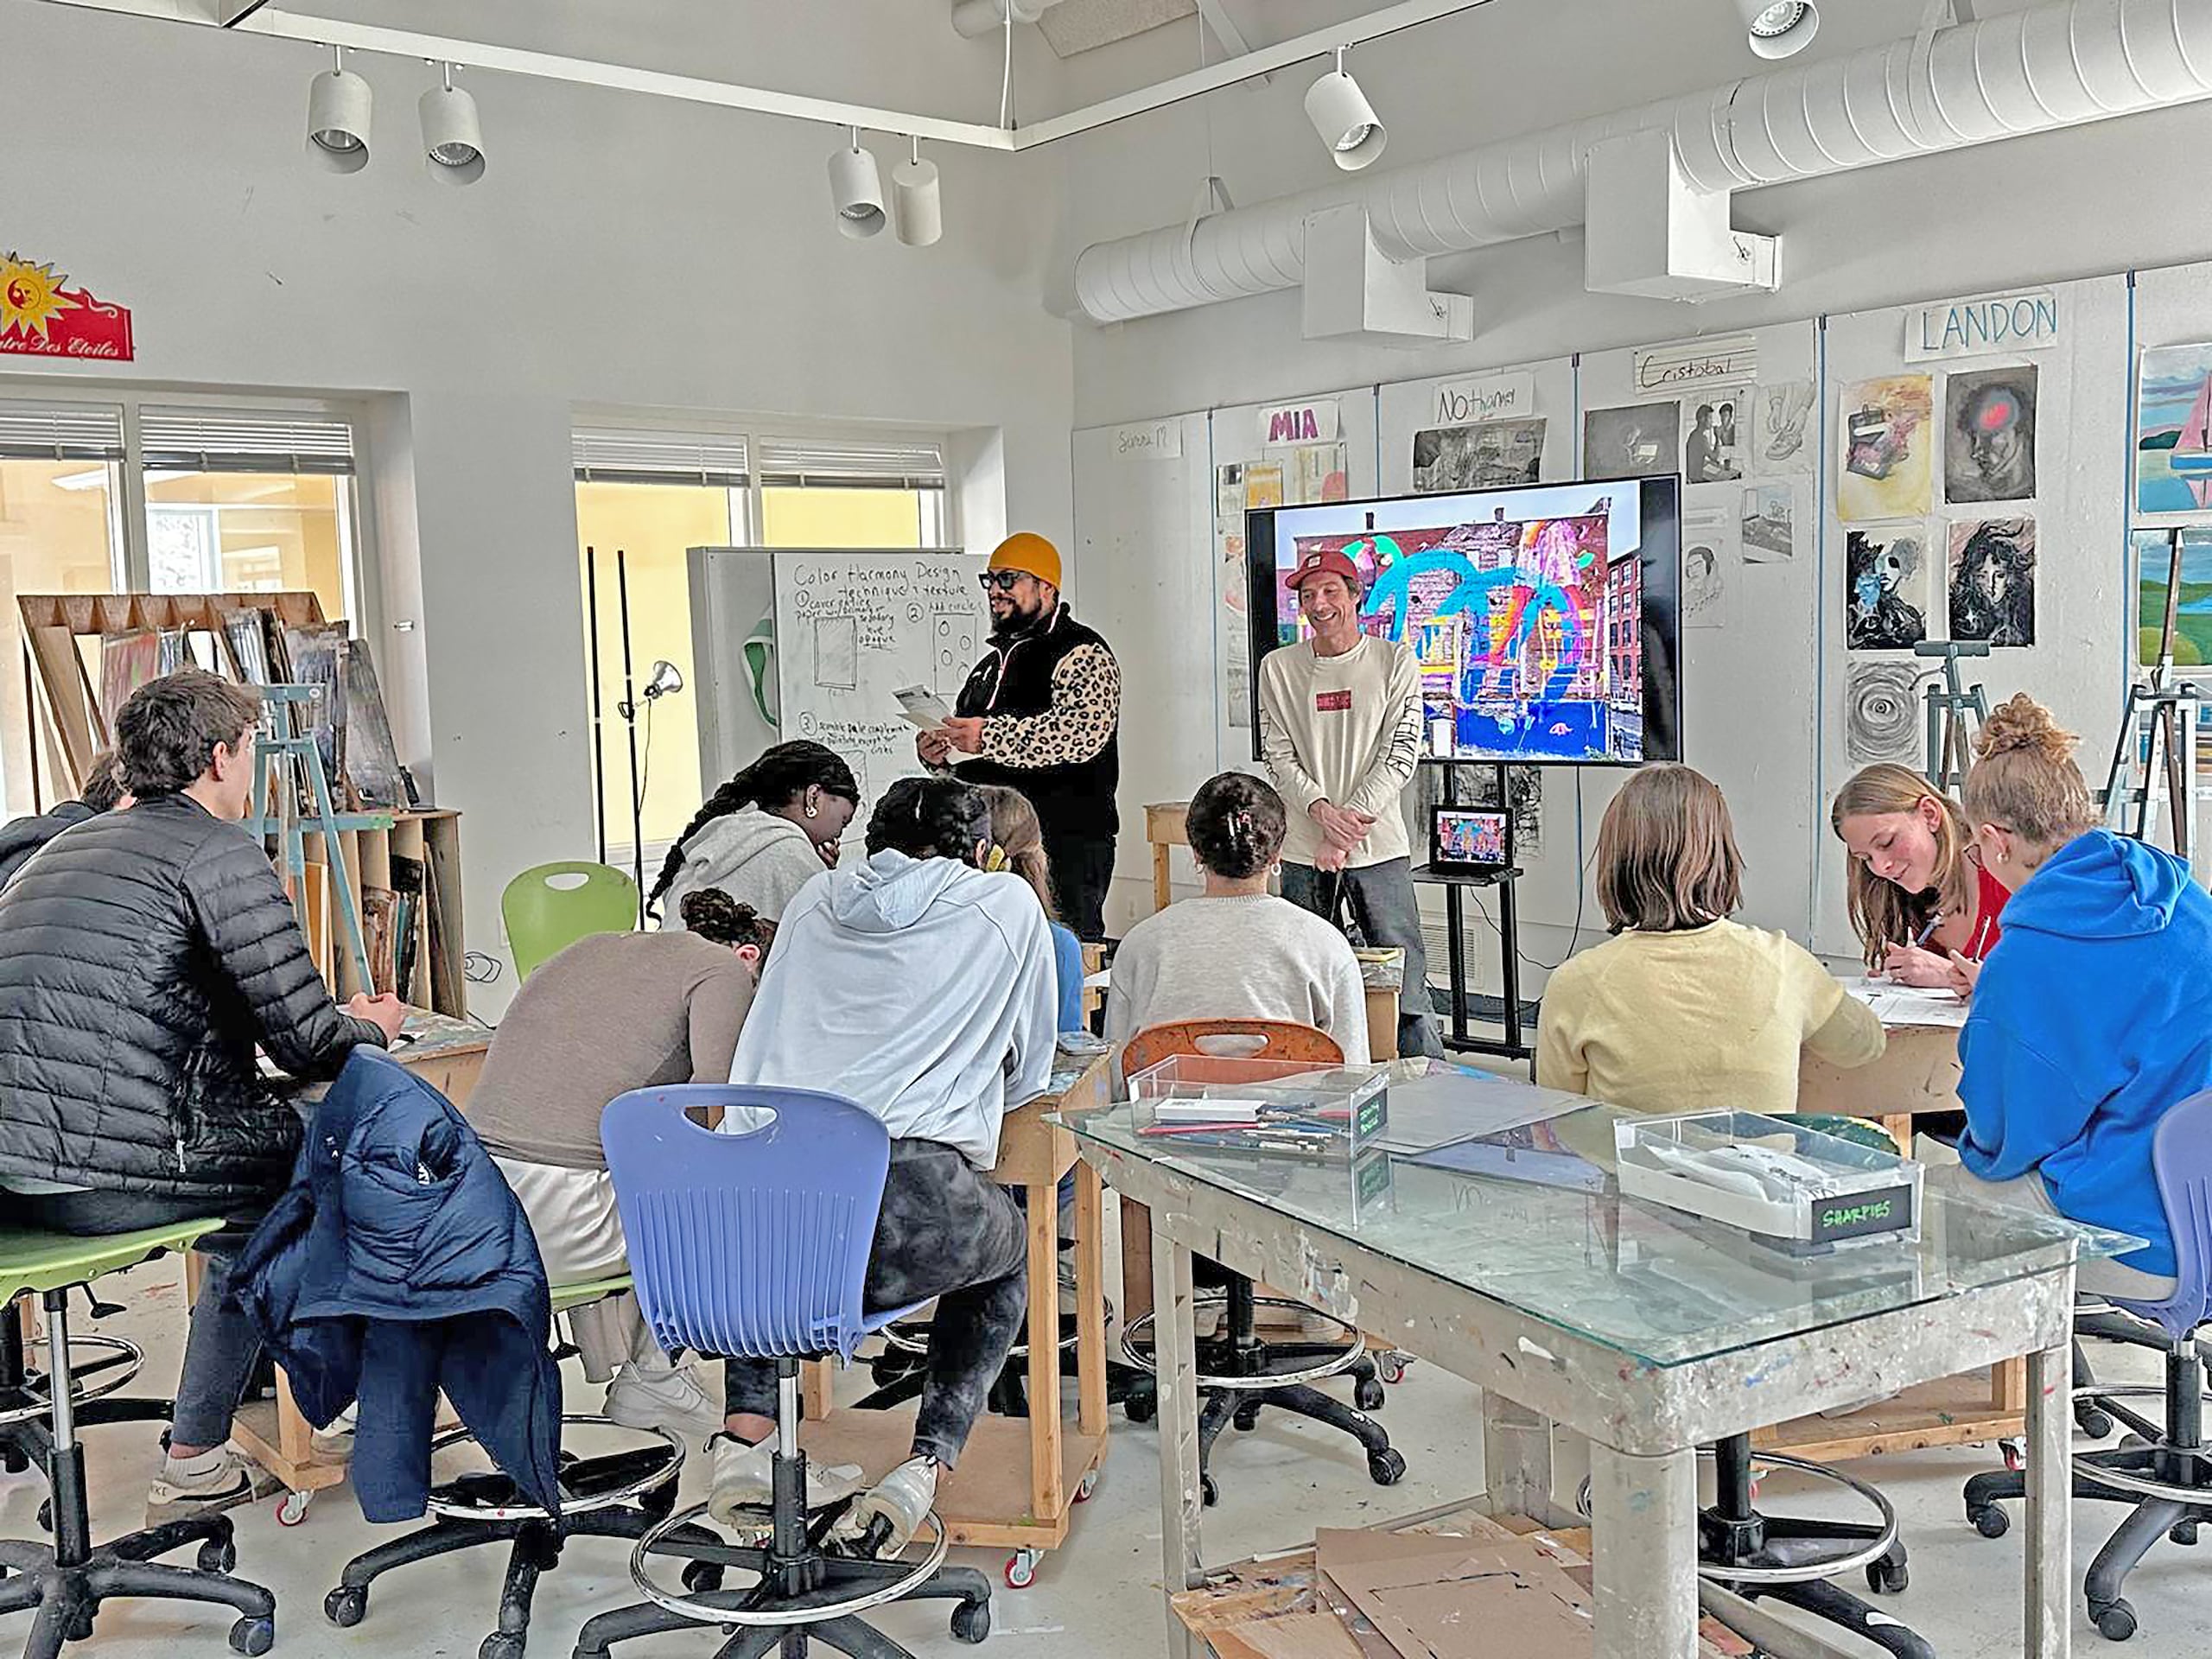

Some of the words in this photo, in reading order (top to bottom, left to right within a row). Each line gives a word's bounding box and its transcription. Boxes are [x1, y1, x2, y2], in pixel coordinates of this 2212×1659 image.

[1923, 298, 2056, 350] LANDON
[29, 334, 61, 353] Des
[67, 336, 118, 356] Etoiles
[1641, 354, 1731, 388] Cristobal
[1268, 409, 1319, 442] MIA
[794, 563, 837, 586] Color
[848, 563, 909, 592] Harmony
[915, 561, 962, 582] Design
[838, 584, 906, 602] technique
[923, 582, 969, 596] texture
[1822, 1199, 1891, 1228] SHARPIES
